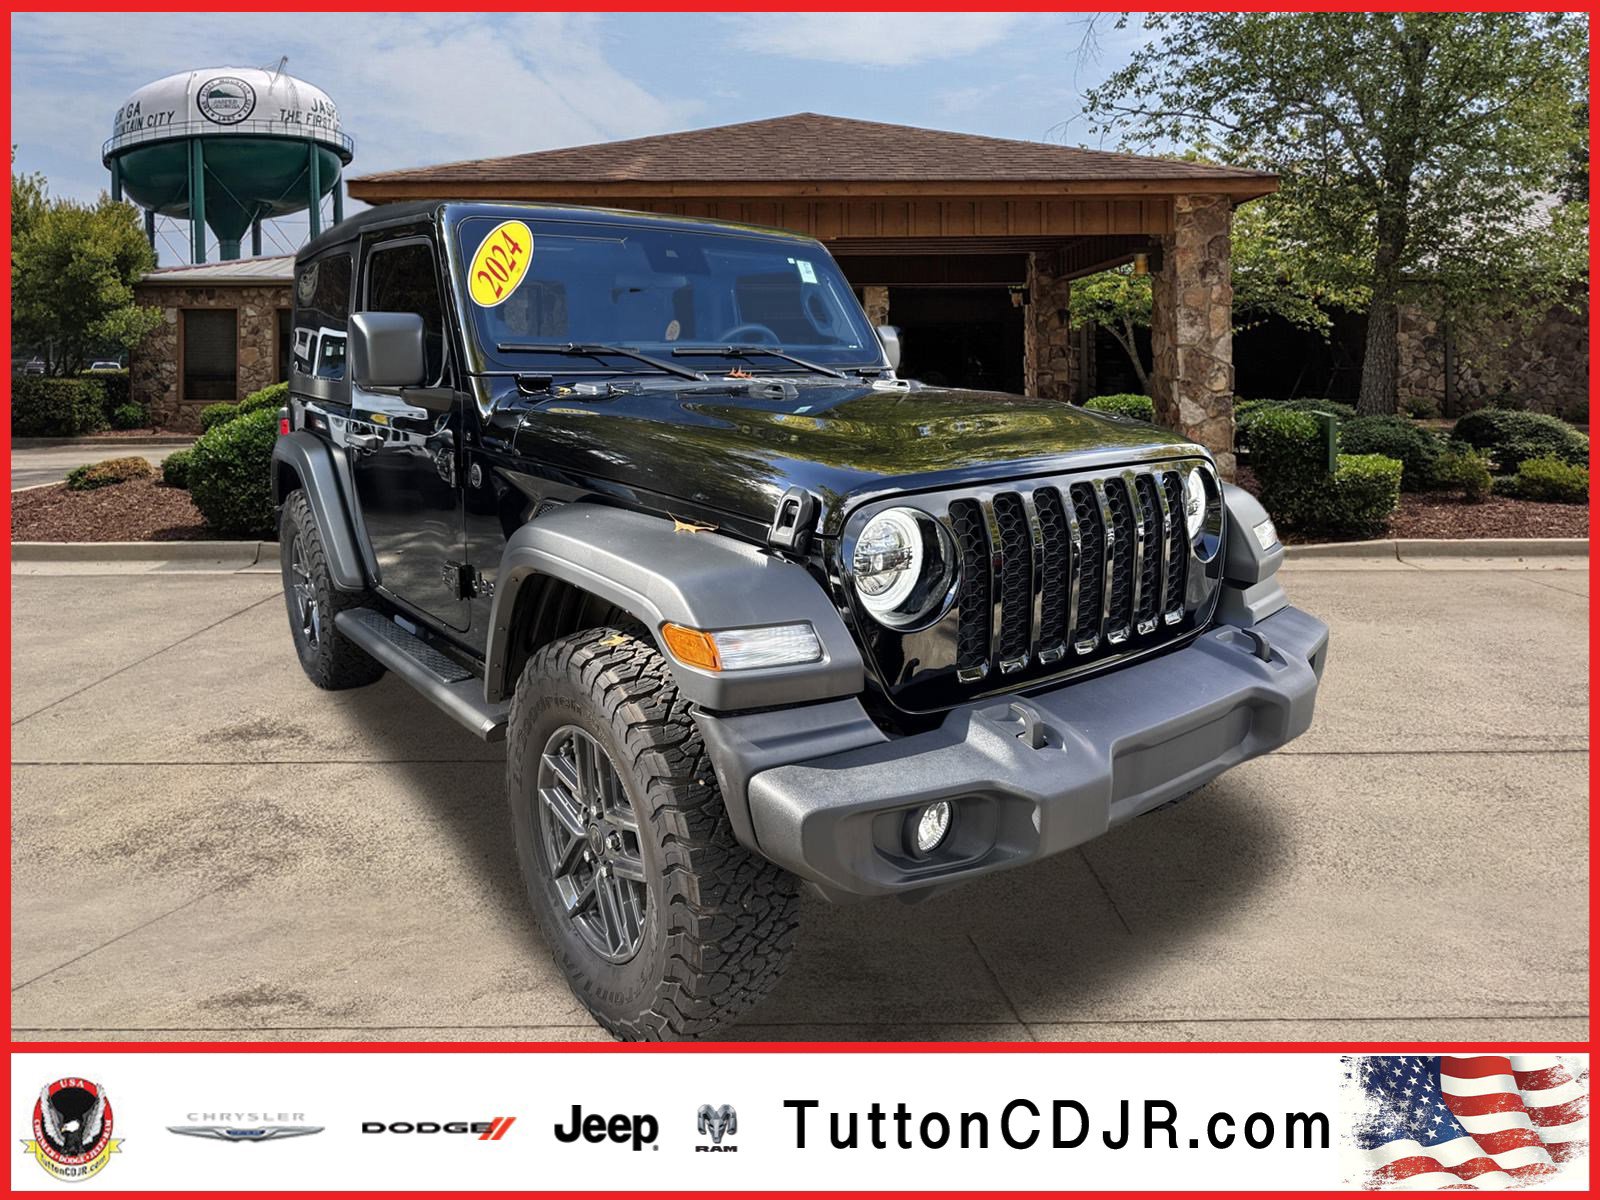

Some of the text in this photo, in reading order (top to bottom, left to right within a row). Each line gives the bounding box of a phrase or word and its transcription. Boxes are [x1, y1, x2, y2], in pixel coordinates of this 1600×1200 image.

[126, 100, 141, 119] GA
[147, 110, 176, 128] CITY
[280, 108, 302, 124] THE
[306, 112, 332, 130] FIRST
[477, 229, 523, 299] 2024
